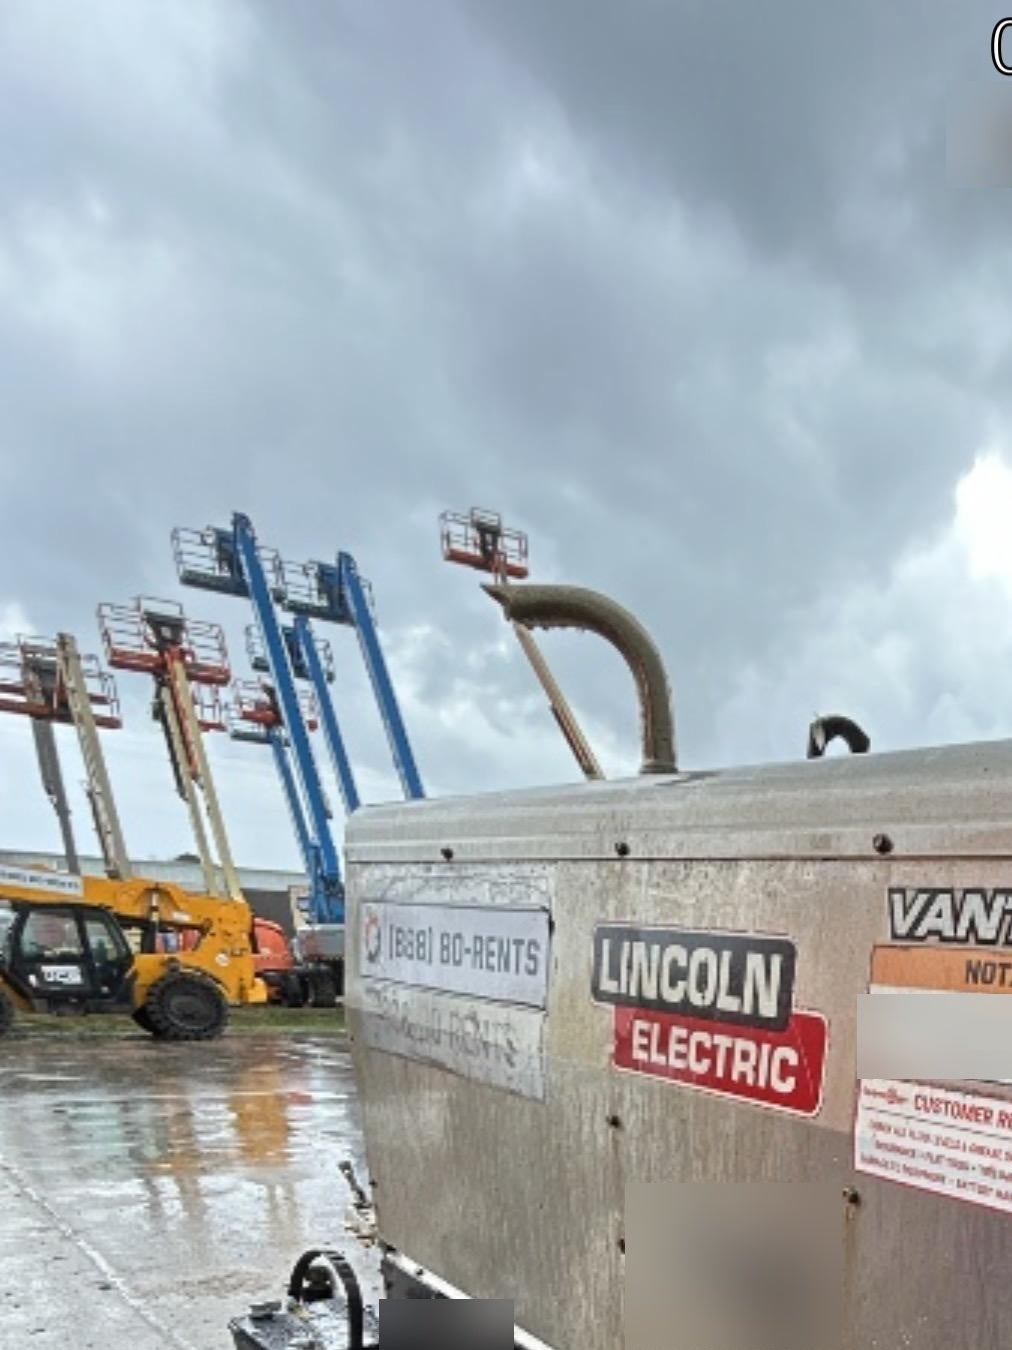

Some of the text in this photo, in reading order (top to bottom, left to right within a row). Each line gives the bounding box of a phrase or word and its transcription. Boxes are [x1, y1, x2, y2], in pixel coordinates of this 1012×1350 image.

[600, 937, 782, 1019] LINCOLN
[631, 1019, 799, 1094] ELECTRIC
[914, 1093, 993, 1126] CUSTOMER
